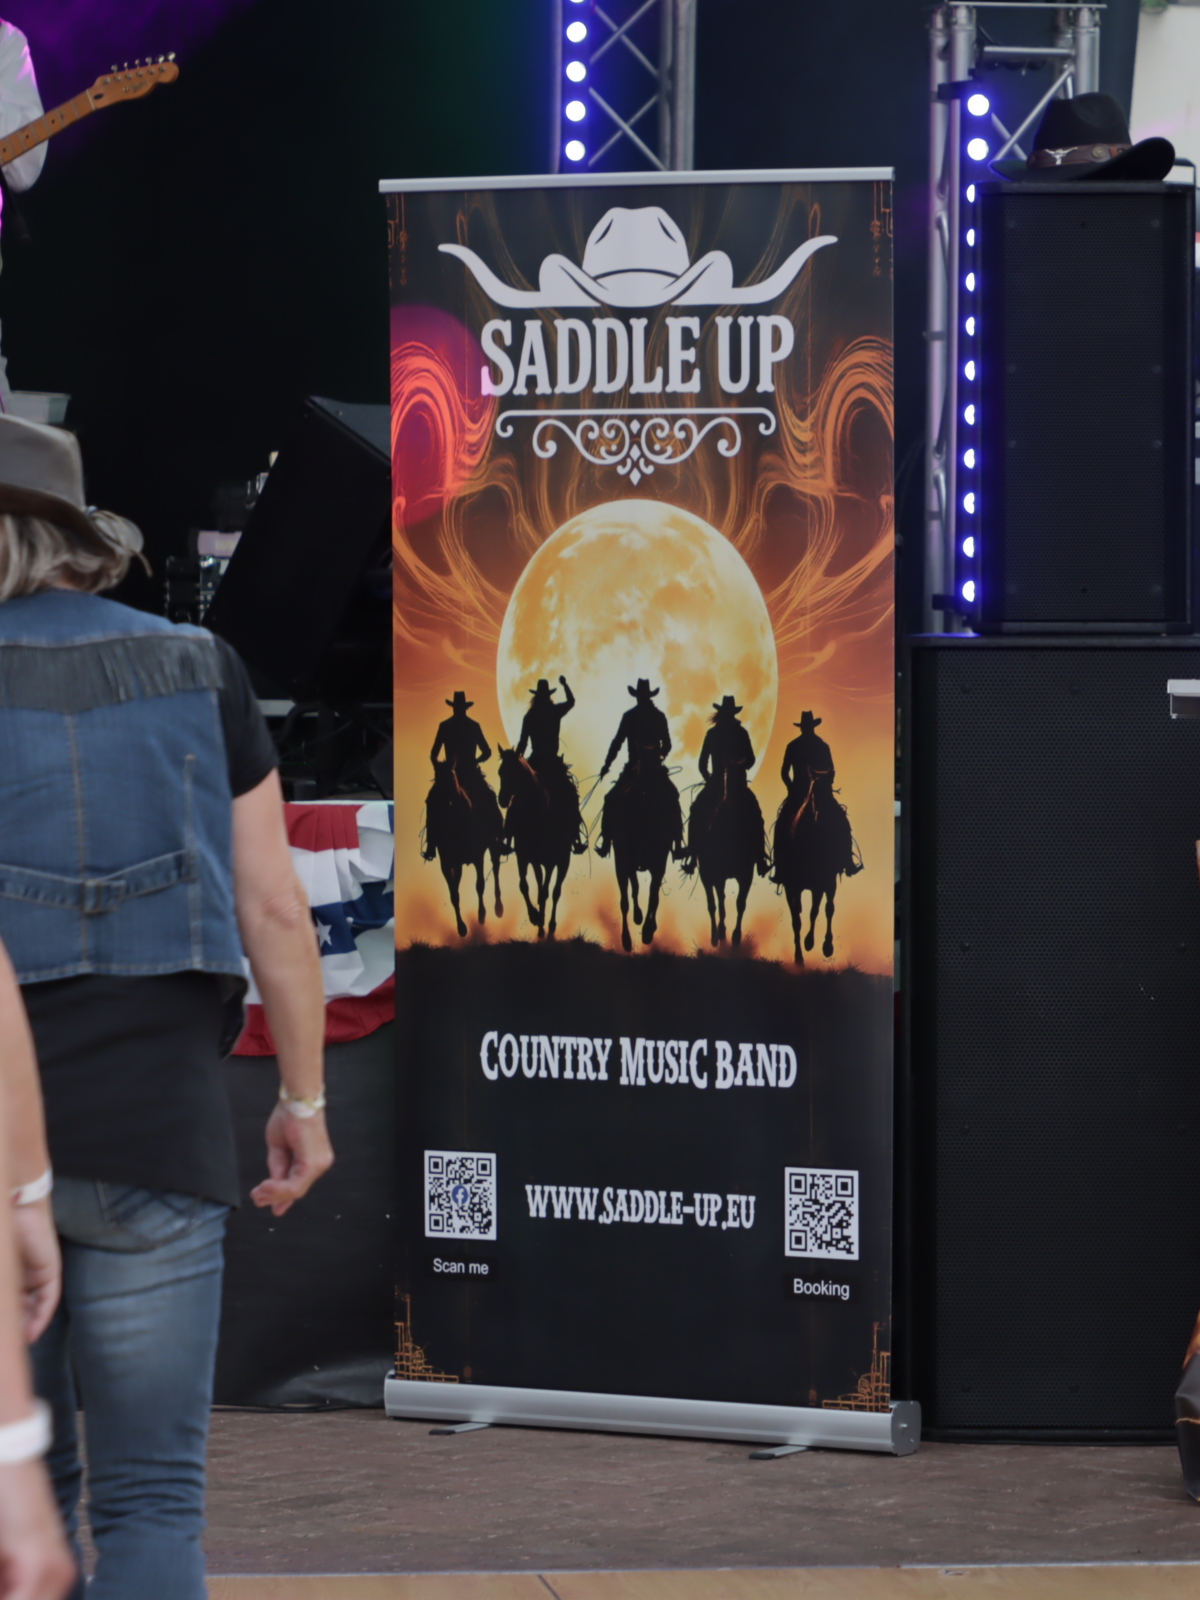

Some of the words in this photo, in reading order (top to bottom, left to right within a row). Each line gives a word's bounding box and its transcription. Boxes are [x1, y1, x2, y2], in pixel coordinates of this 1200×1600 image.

[481, 316, 701, 396] SADDLE
[715, 315, 794, 394] UP
[480, 1030, 612, 1081] COUNTRY
[619, 1036, 708, 1089] MUSIC
[715, 1040, 797, 1089] BAND
[525, 1184, 756, 1230] WWW.SADDLE-UP.EU
[433, 1258, 465, 1273] Scan
[469, 1262, 489, 1274] me
[793, 1278, 850, 1299] Booking
